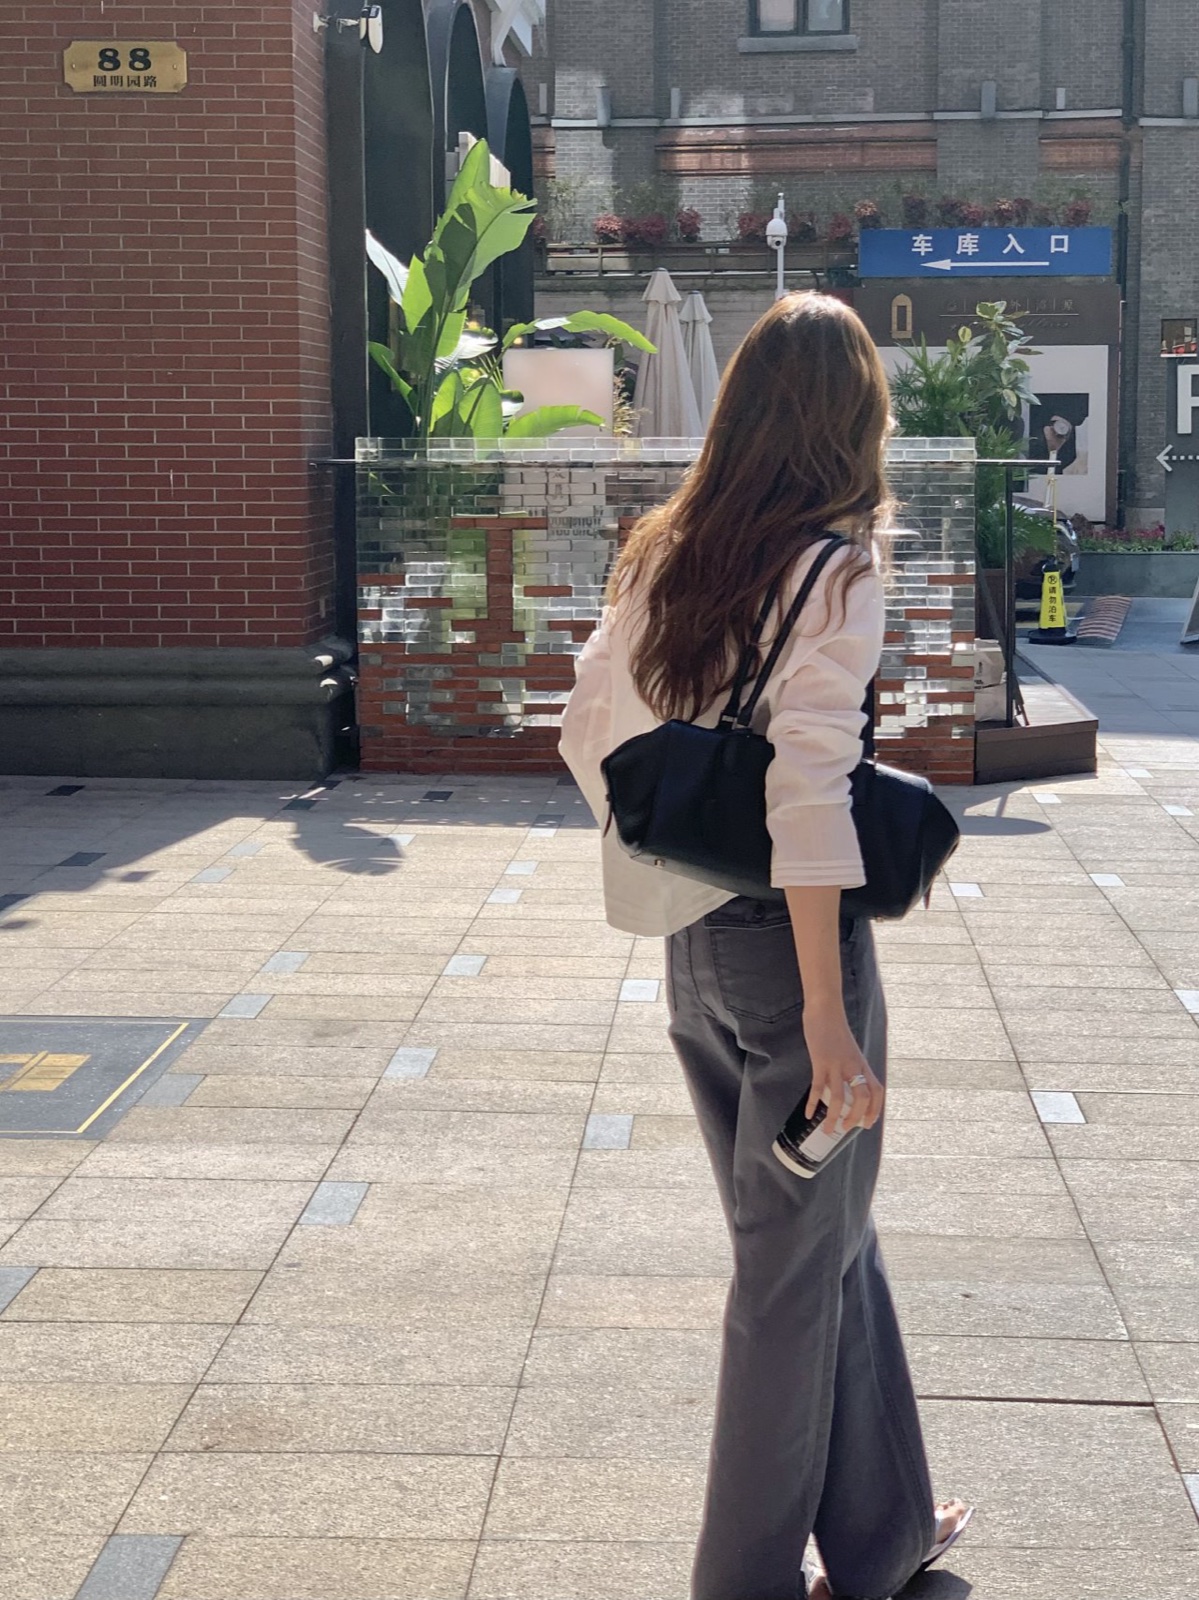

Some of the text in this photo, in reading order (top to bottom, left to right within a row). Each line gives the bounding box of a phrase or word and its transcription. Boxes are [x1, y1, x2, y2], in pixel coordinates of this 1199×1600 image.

[98, 48, 152, 71] 88
[93, 75, 157, 87] 圆明园路
[911, 233, 1069, 256] 车库入口
[1048, 586, 1057, 622] 请勿泊车
